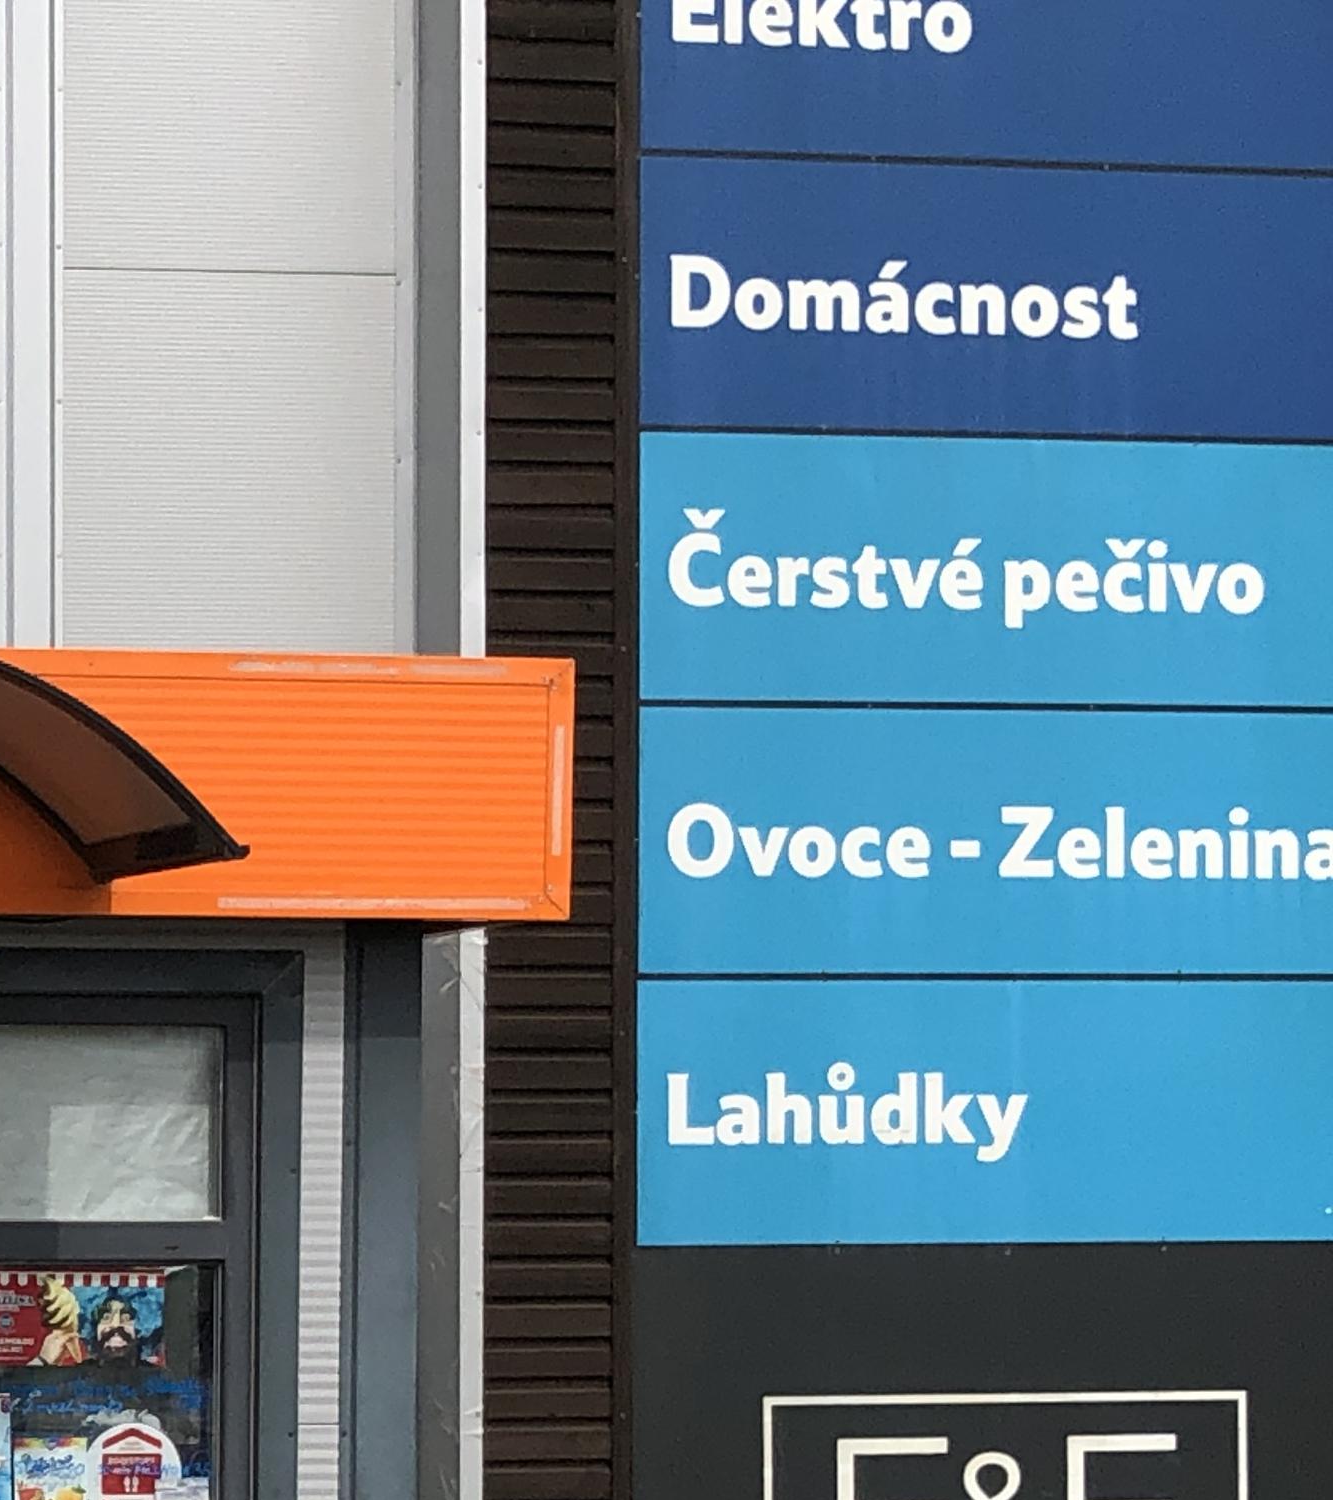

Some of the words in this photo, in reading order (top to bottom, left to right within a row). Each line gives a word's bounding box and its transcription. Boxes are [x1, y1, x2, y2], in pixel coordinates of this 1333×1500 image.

[670, 0, 973, 53] Elektro
[669, 254, 1140, 341] Domácnost
[667, 508, 985, 611] Čerstvé
[1004, 539, 1266, 629] pečivo
[667, 802, 932, 880] Ovoce
[950, 838, 982, 860] -
[666, 1061, 1029, 1164] Lahůdky
